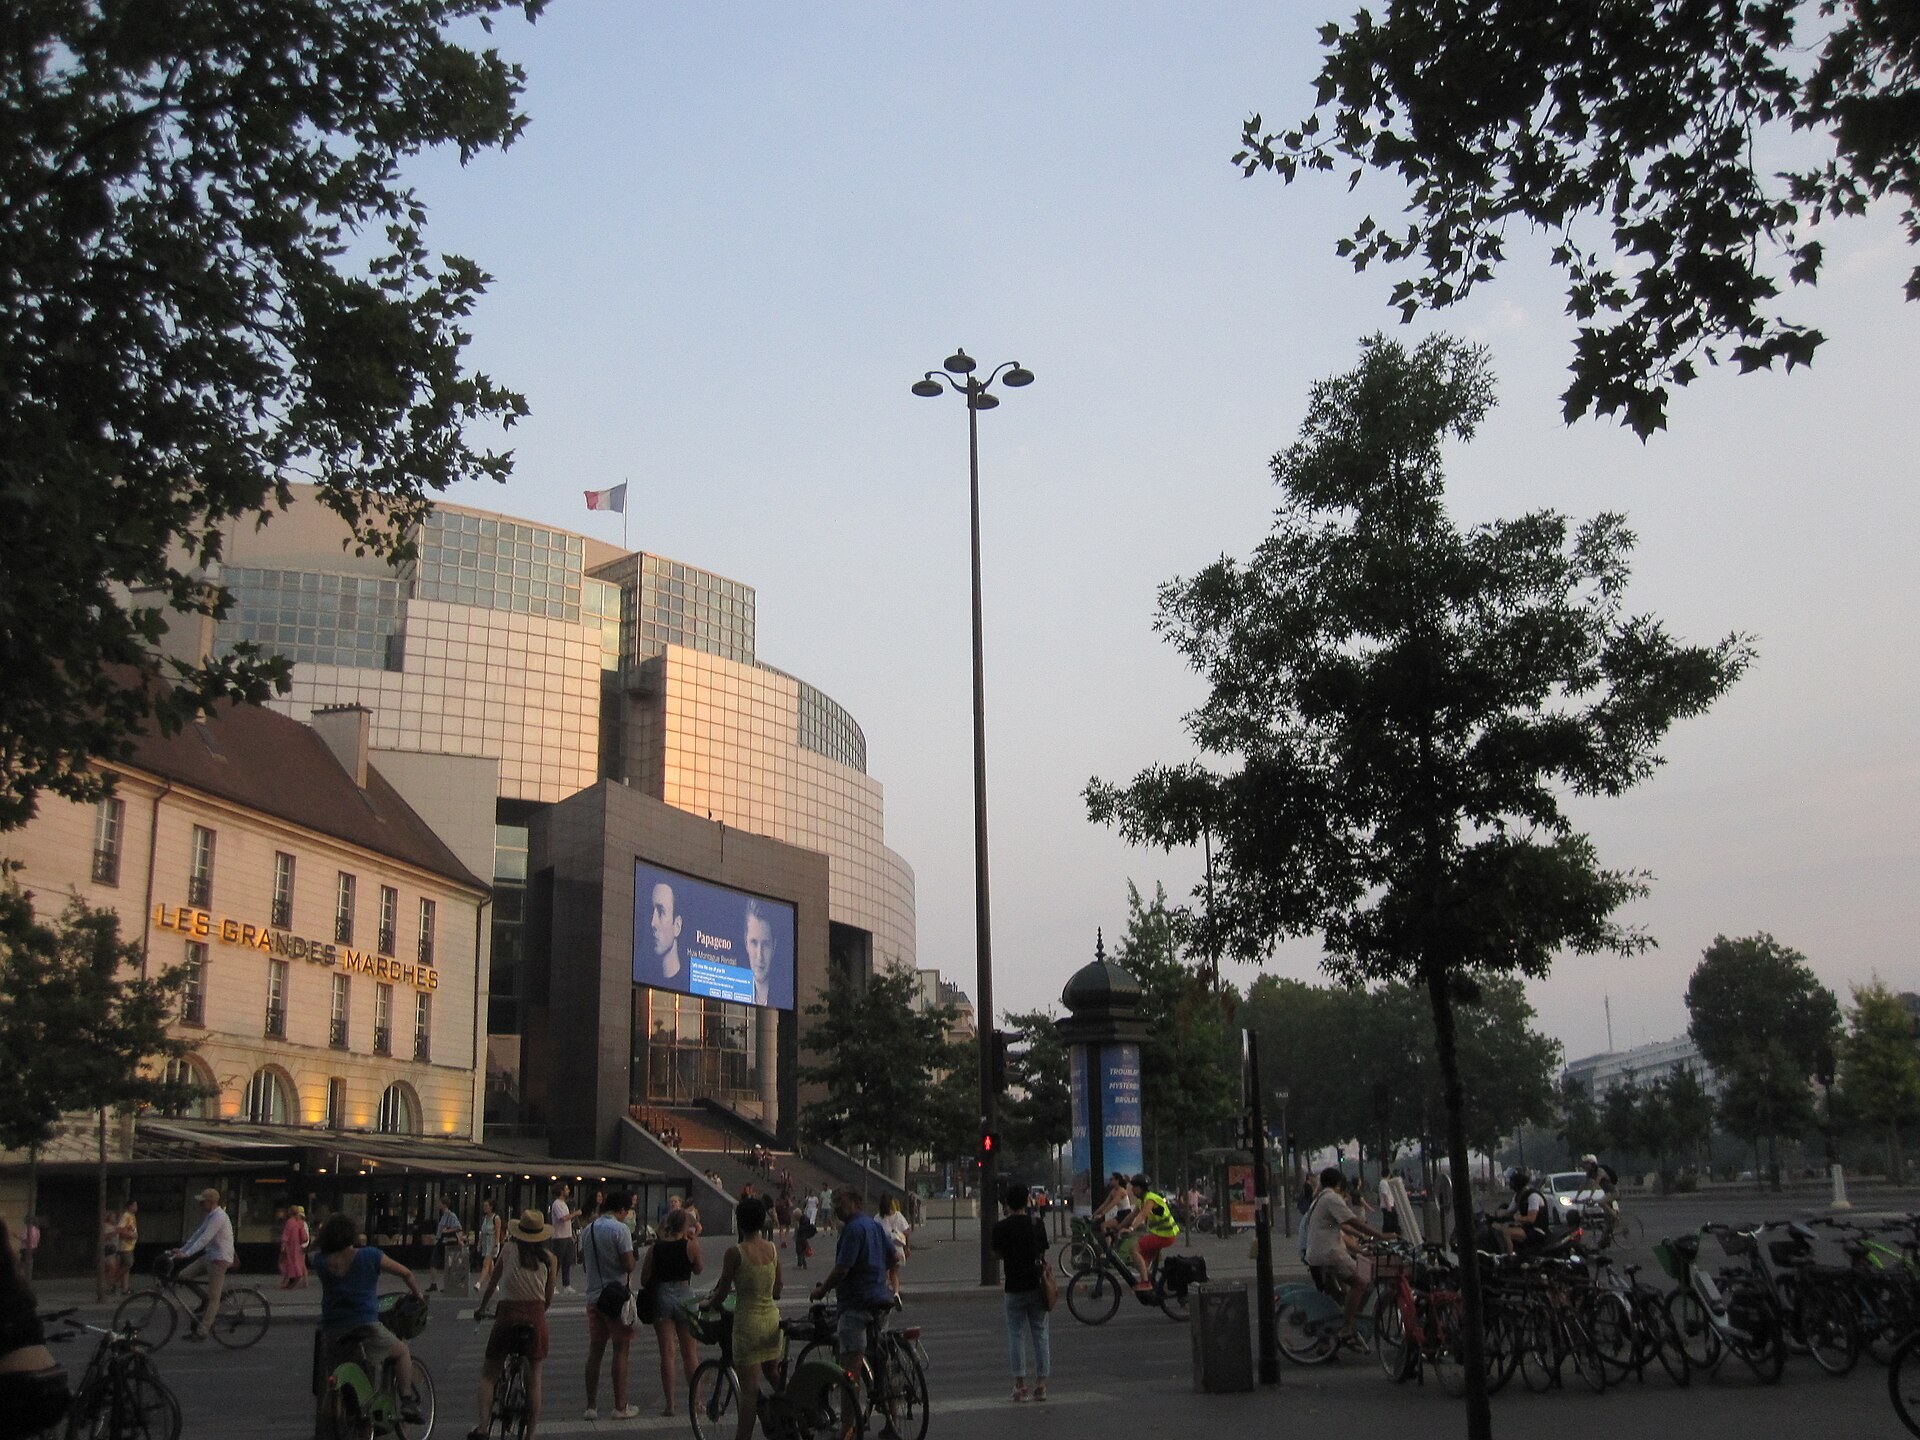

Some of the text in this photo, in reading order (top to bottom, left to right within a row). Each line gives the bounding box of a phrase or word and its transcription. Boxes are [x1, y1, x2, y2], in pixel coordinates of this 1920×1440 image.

[158, 903, 439, 989] LES GRANDES MARCHES
[696, 930, 732, 951] Papageno
